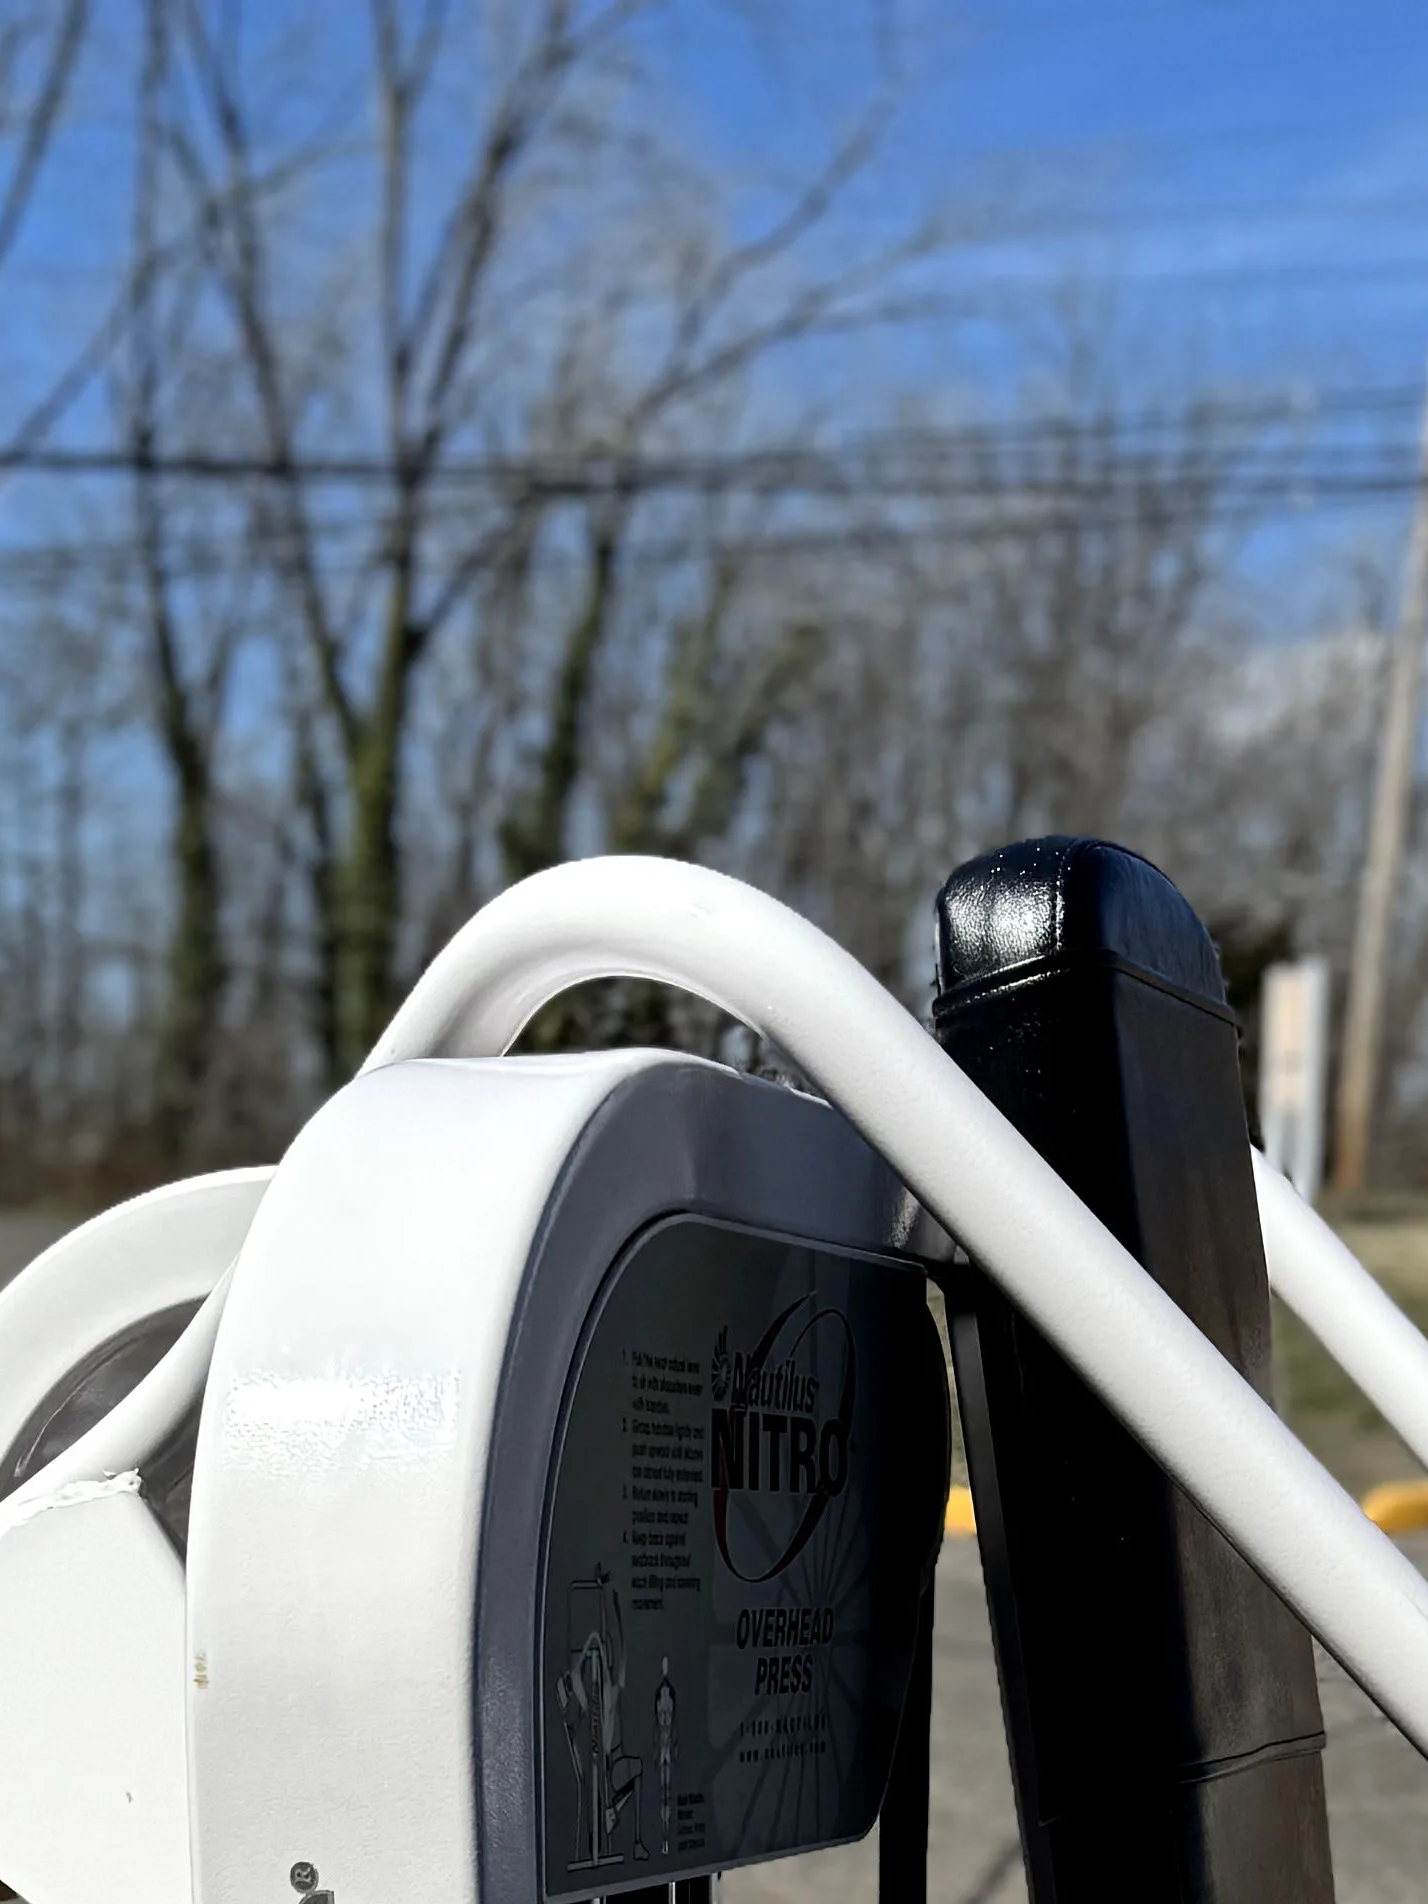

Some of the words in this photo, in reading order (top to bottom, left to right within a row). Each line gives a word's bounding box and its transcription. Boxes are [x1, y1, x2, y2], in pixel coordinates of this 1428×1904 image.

[731, 1351, 817, 1412] Nautilus
[711, 1408, 849, 1497] NITRO
[737, 1608, 834, 1649] OVERHEAD
[755, 1655, 813, 1695] PRESS
